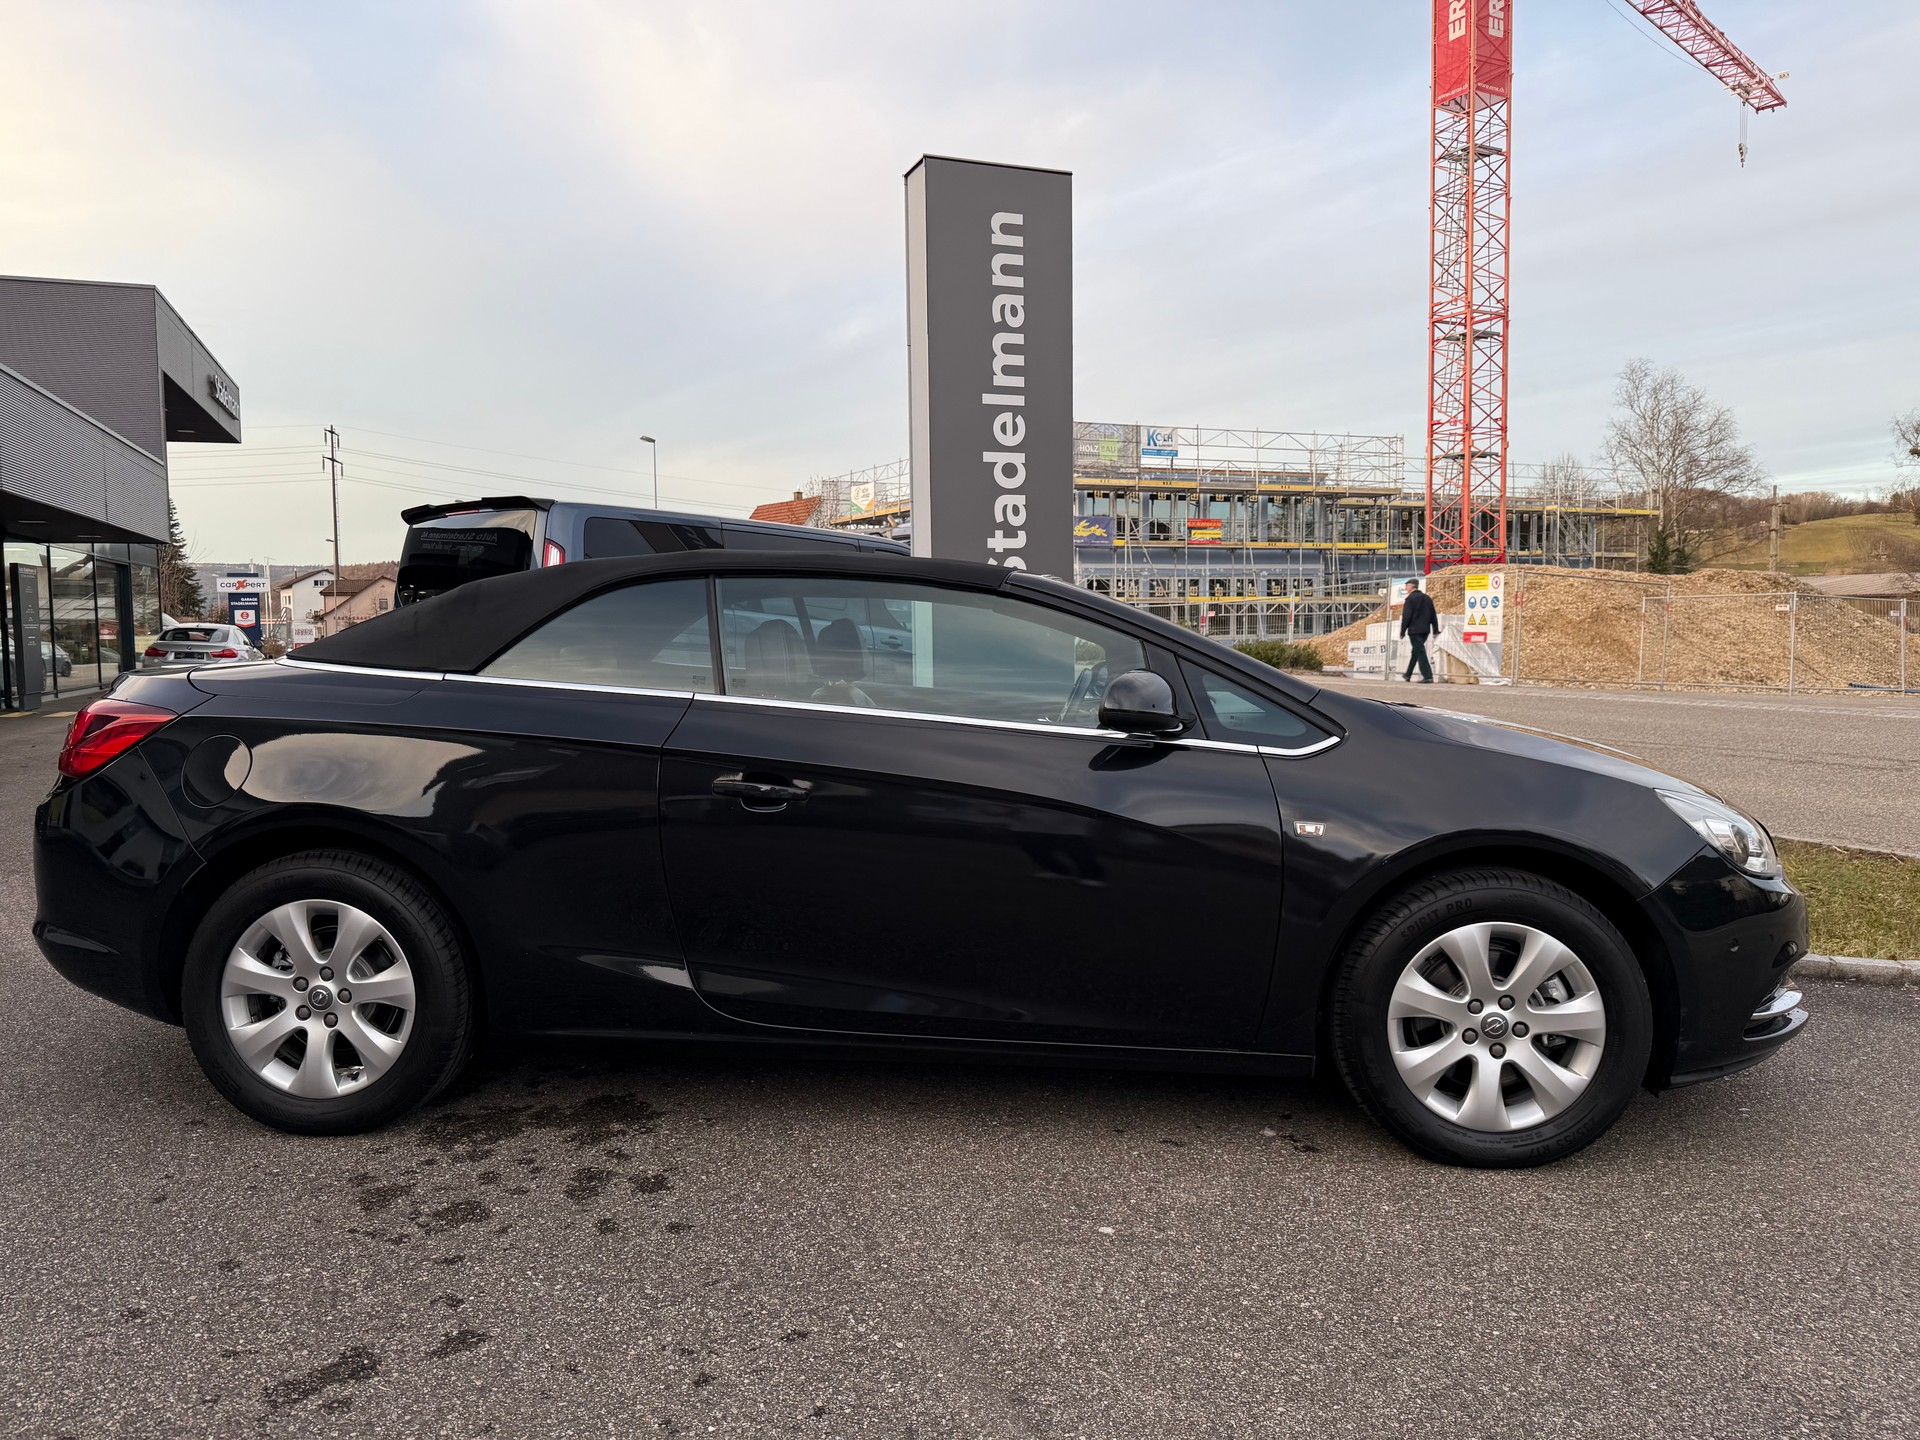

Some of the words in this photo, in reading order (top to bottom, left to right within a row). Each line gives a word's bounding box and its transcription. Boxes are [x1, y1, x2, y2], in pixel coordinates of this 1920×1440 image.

[1079, 444, 1099, 453] HOLZ
[1401, 909, 1440, 940] SPIRIT
[1446, 898, 1473, 914] PRO
